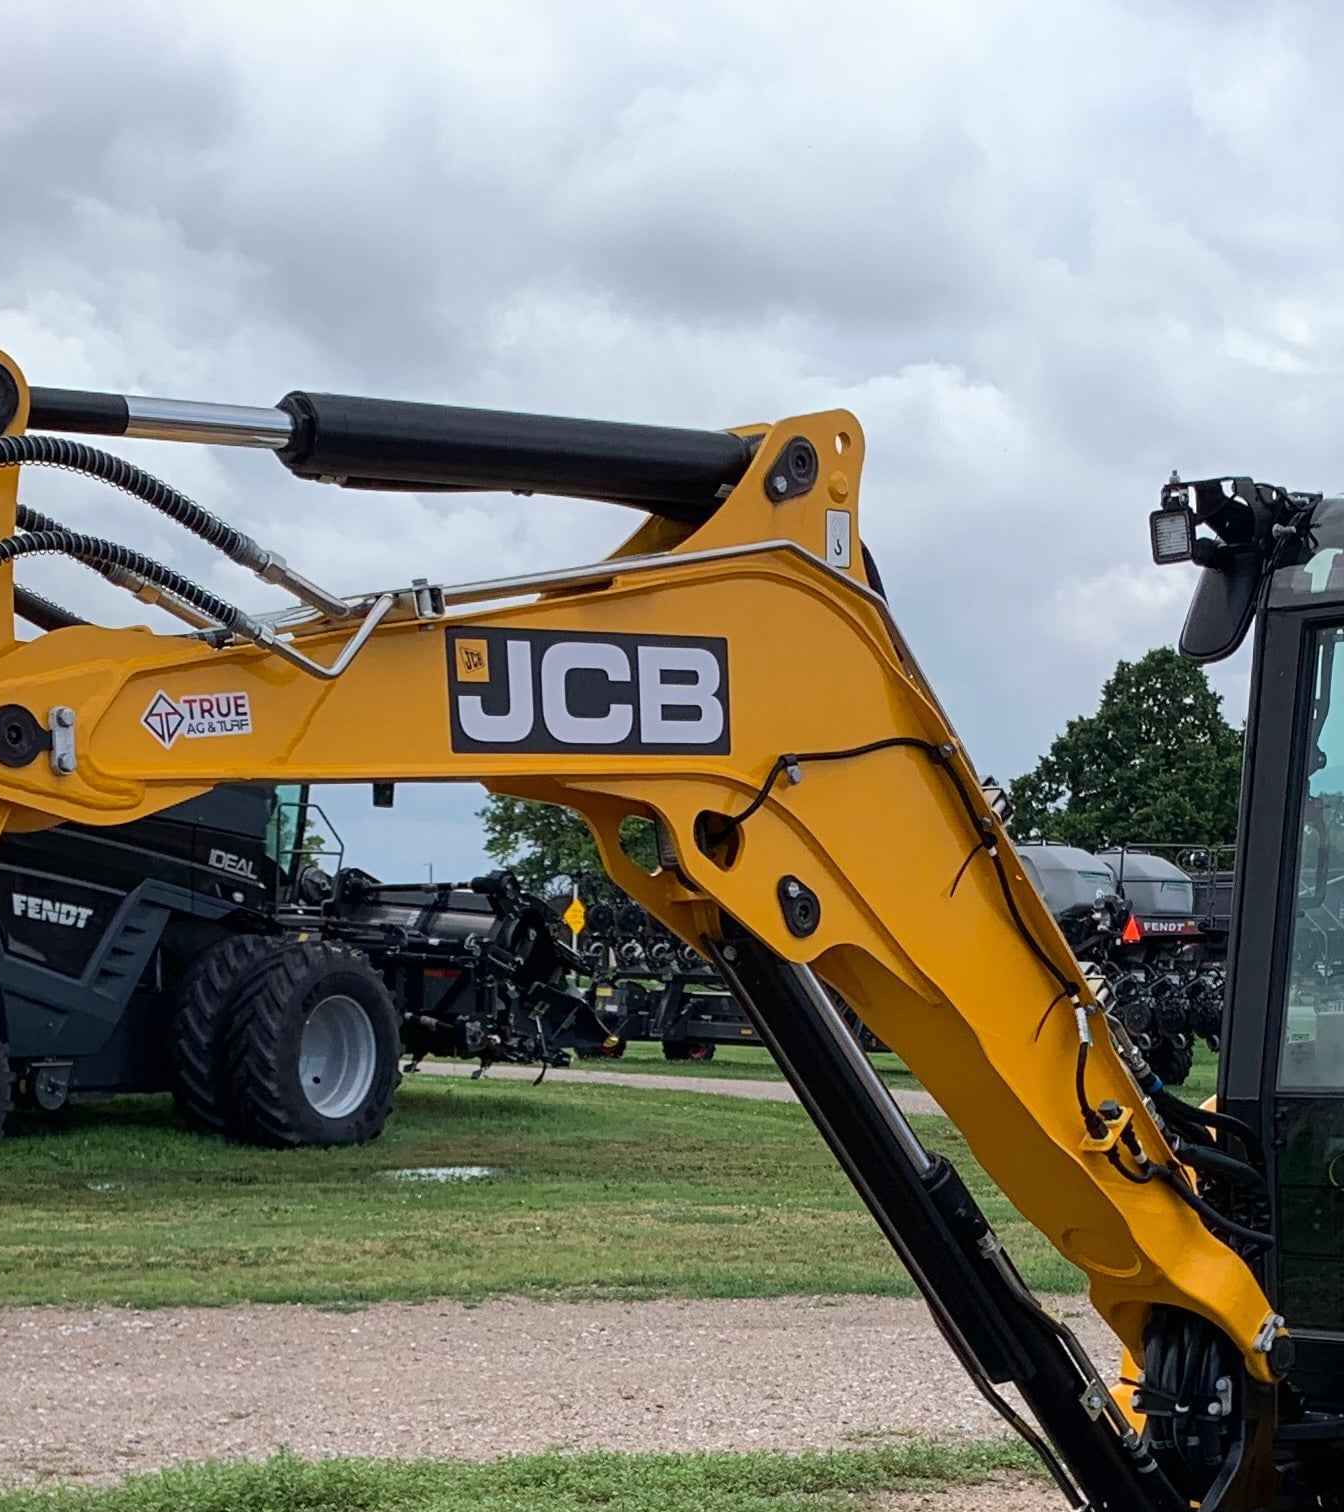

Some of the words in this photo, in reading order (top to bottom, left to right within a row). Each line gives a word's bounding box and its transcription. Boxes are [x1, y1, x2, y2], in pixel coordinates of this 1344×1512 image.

[458, 640, 724, 744] JCB
[183, 696, 248, 720] TRUE
[187, 722, 205, 735] AG
[207, 721, 216, 733] &
[217, 719, 249, 732] TURF
[208, 849, 257, 879] IDEAL
[12, 893, 93, 929] FENDT
[1143, 922, 1185, 932] FENDT
